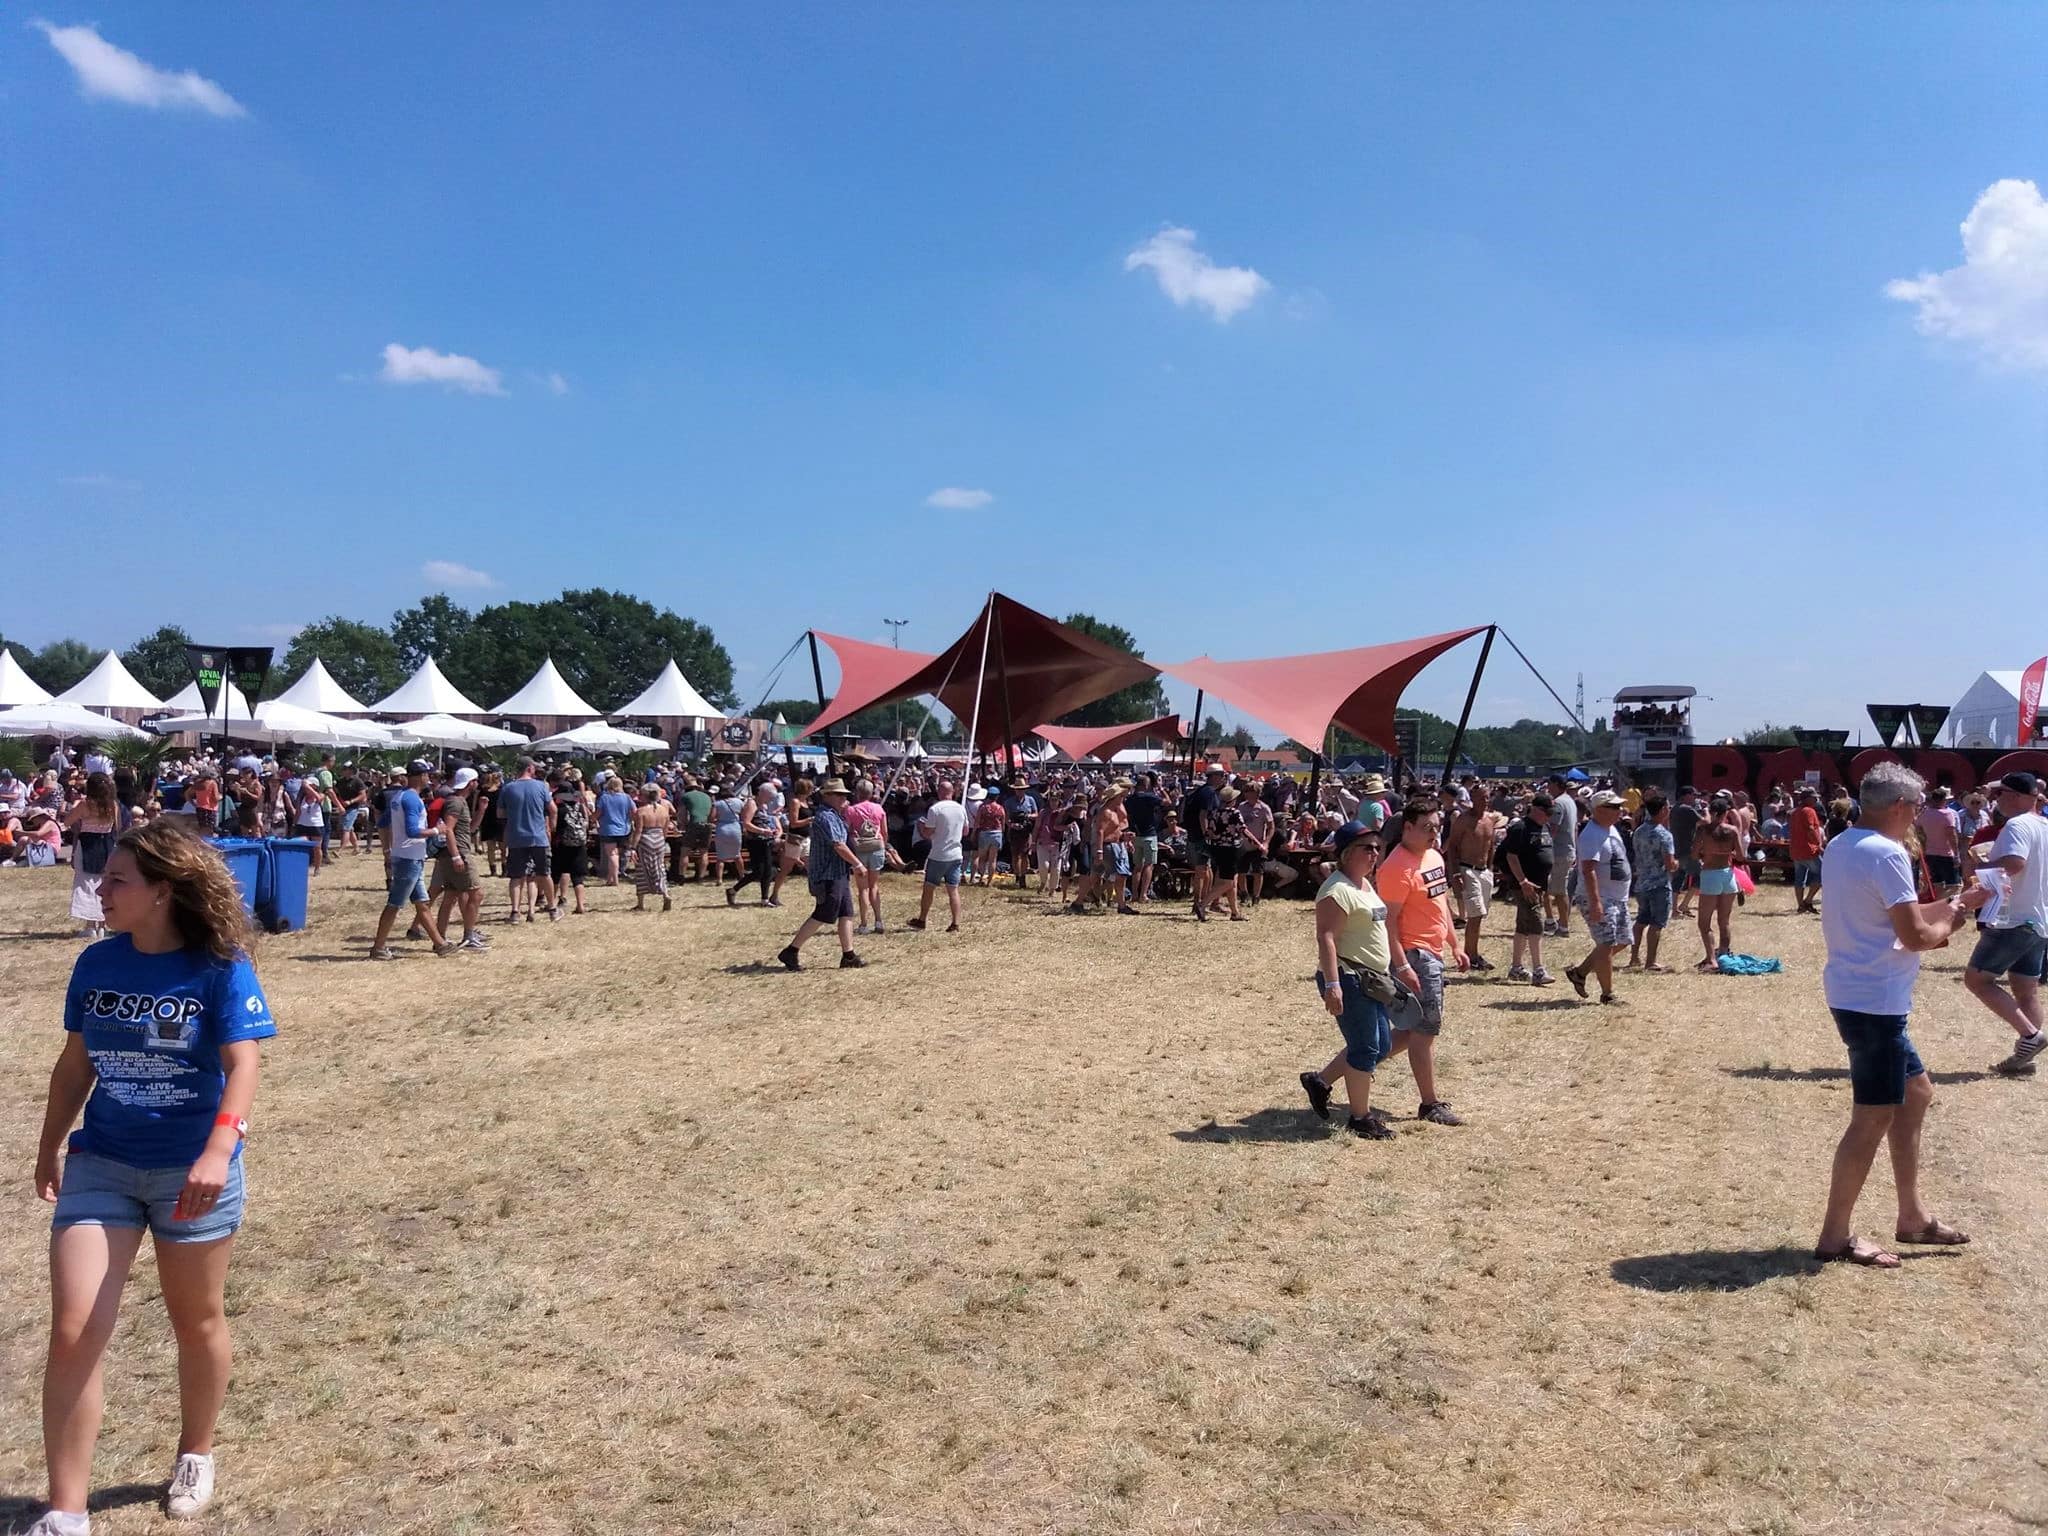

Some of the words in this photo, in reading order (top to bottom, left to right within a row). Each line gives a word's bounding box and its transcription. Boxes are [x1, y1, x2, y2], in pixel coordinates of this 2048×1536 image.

[200, 669, 221, 679] AFVAL
[202, 679, 220, 688] PUNT
[83, 989, 204, 1023] BOSPOP
